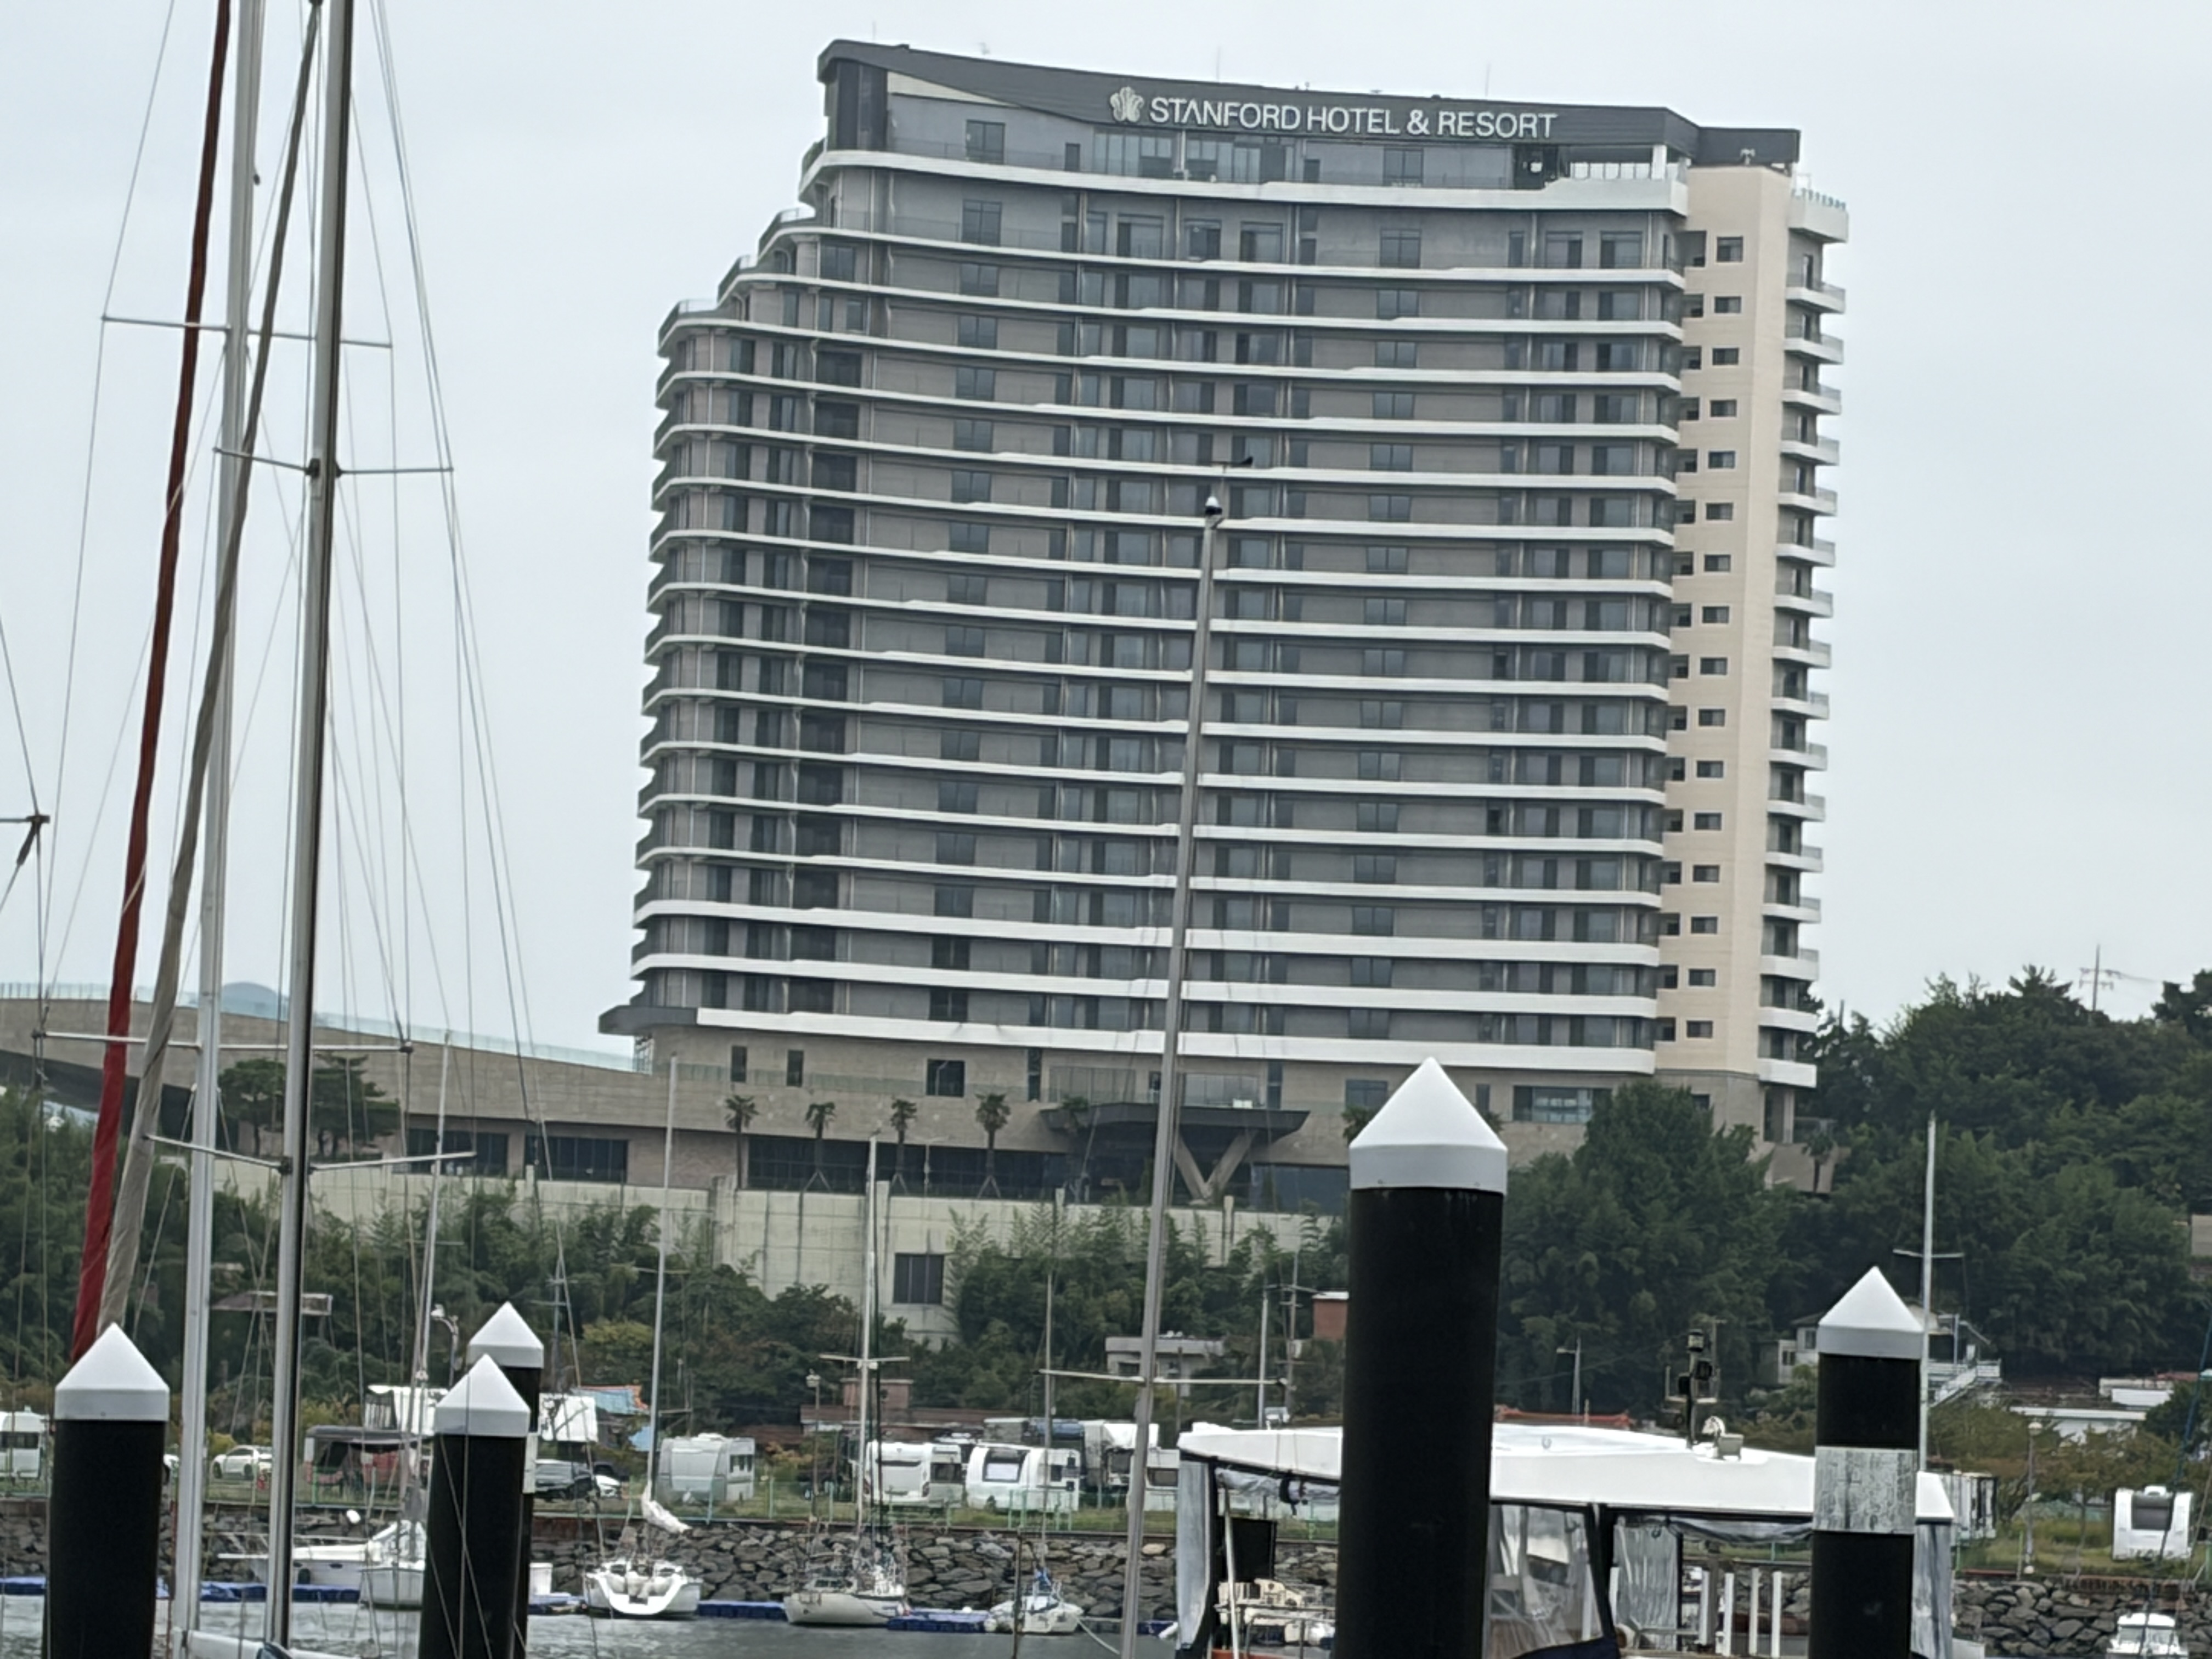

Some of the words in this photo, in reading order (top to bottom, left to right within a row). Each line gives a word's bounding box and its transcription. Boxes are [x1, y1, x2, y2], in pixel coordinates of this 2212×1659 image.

[1149, 97, 1301, 129] STANFORD
[1307, 106, 1400, 134] HOTEL
[1407, 109, 1429, 135] &
[1438, 111, 1558, 138] RESORT
